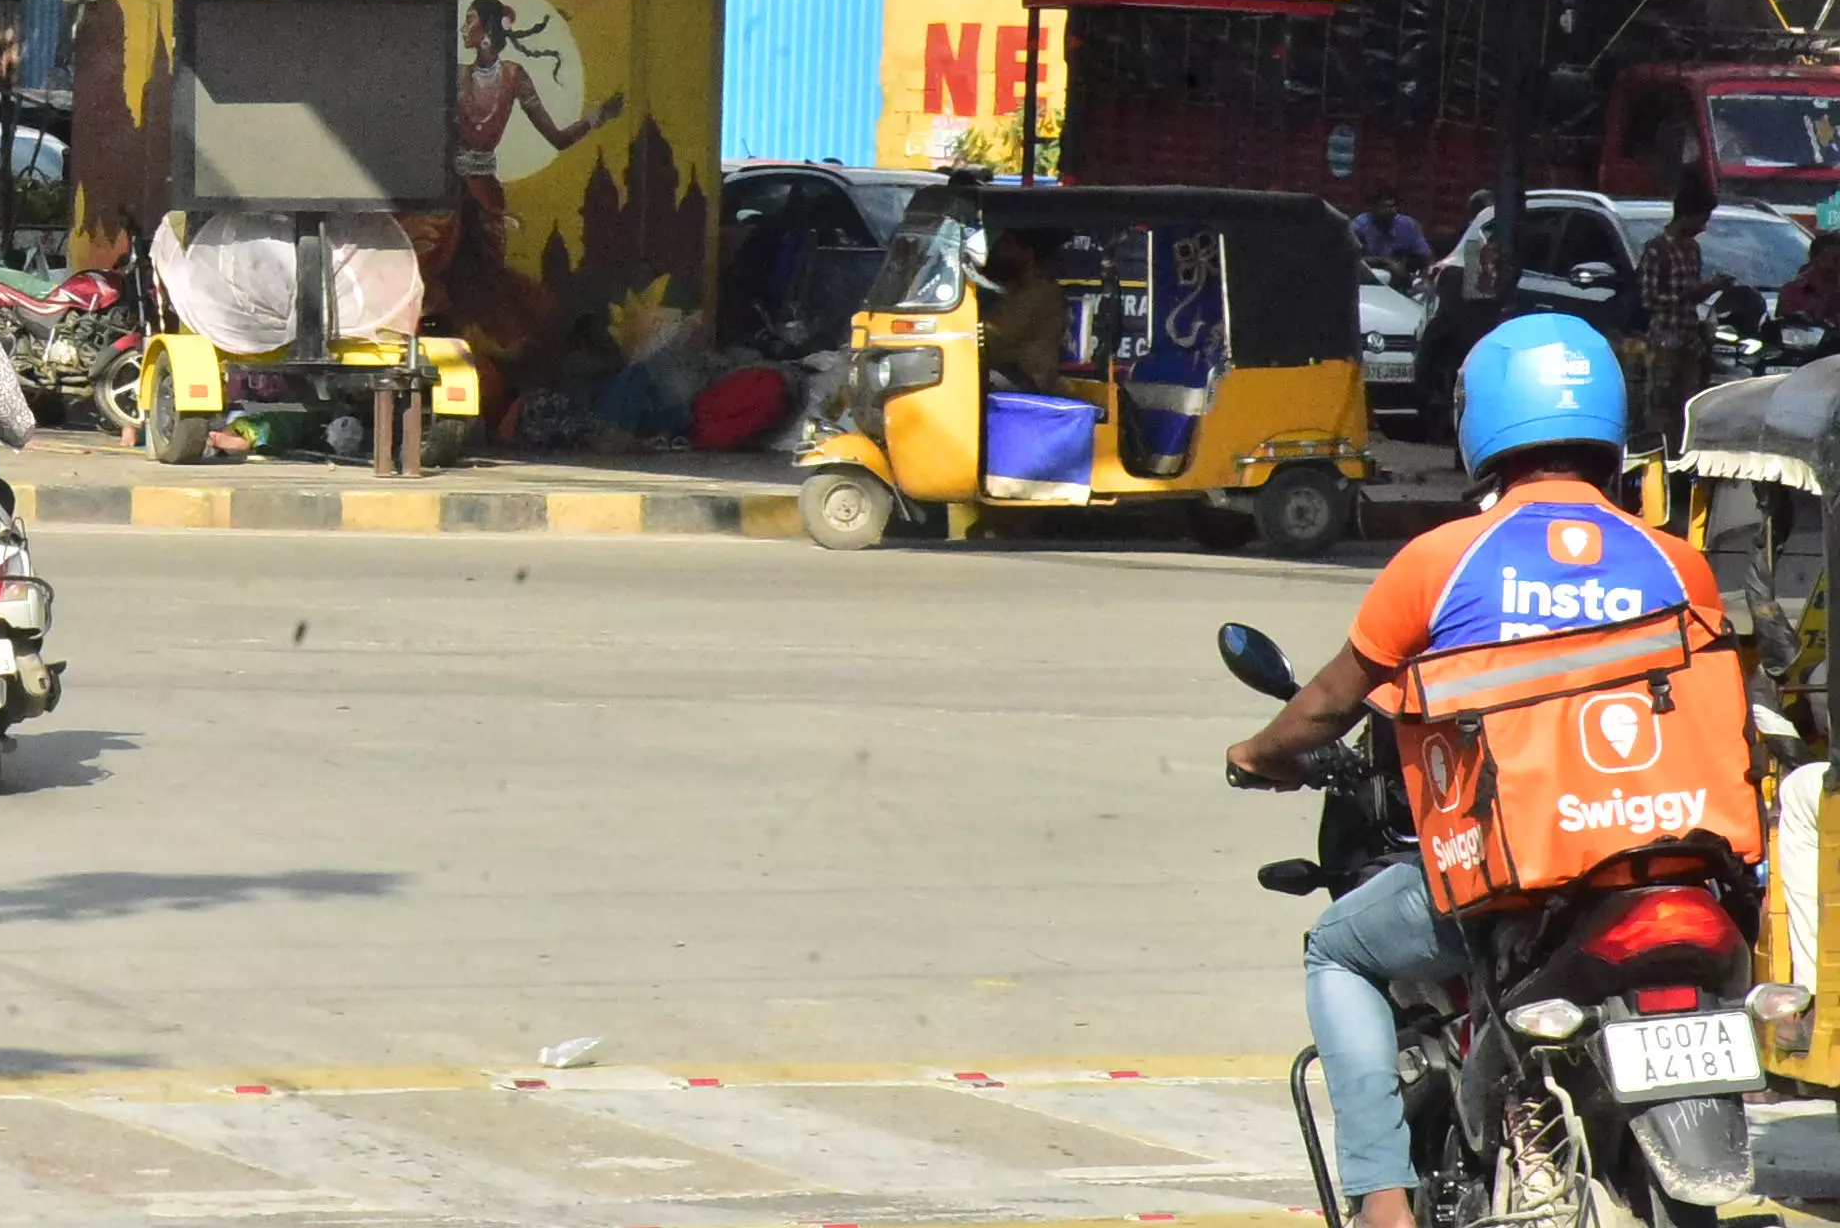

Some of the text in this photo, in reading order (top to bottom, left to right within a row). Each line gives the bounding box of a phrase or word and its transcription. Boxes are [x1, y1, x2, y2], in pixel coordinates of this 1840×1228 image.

[1500, 566, 1644, 623] insta
[1557, 788, 1708, 834] Swiggy
[1635, 1020, 1732, 1052] TG07A
[1645, 1049, 1737, 1083] A4181
